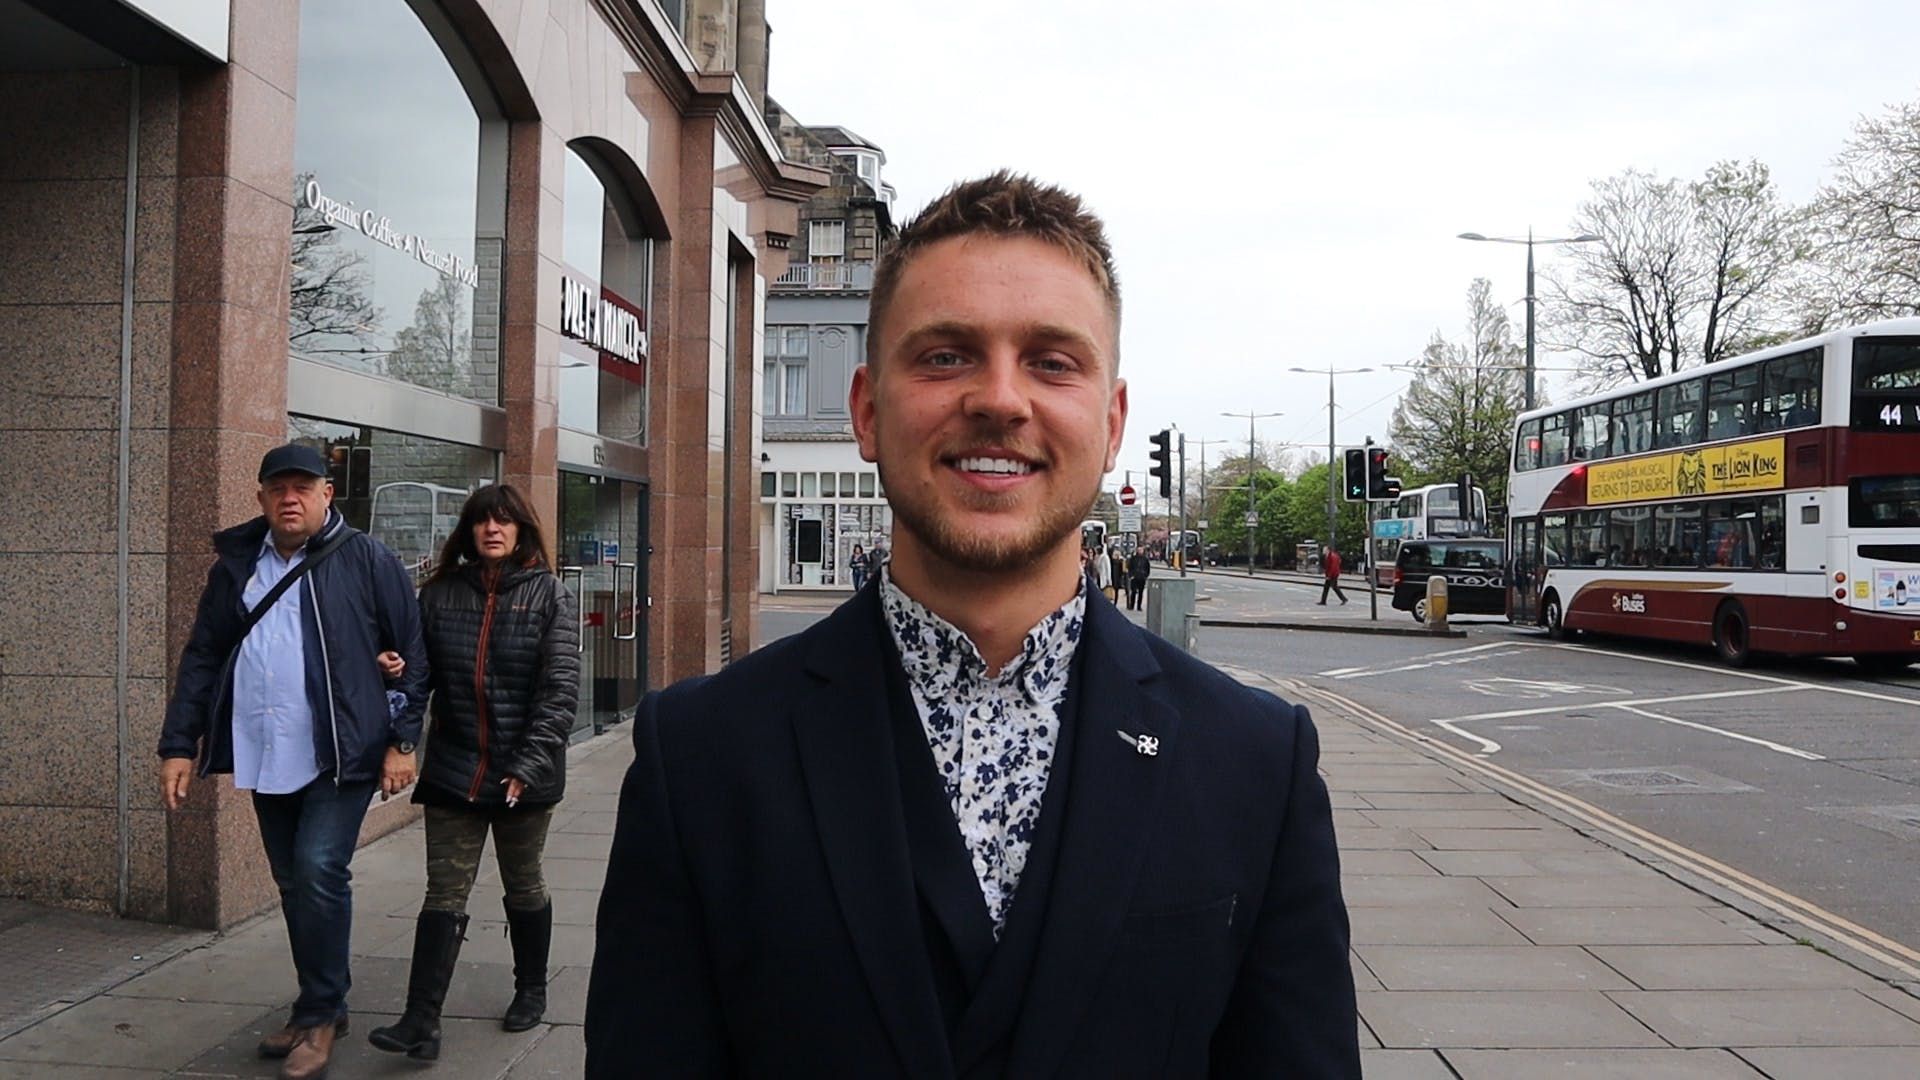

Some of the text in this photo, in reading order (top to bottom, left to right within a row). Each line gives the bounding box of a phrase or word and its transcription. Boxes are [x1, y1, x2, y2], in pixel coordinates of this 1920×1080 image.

[305, 180, 479, 288] Organic Coffee Natural Food
[563, 275, 592, 341] PRET
[1880, 404, 1902, 426] 44
[1712, 462, 1728, 478] THE
[1729, 456, 1751, 480] LION
[1753, 453, 1777, 478] KING
[1619, 481, 1630, 496] TO
[1631, 476, 1673, 494] EDINBURGH
[1451, 575, 1504, 587] TAXI
